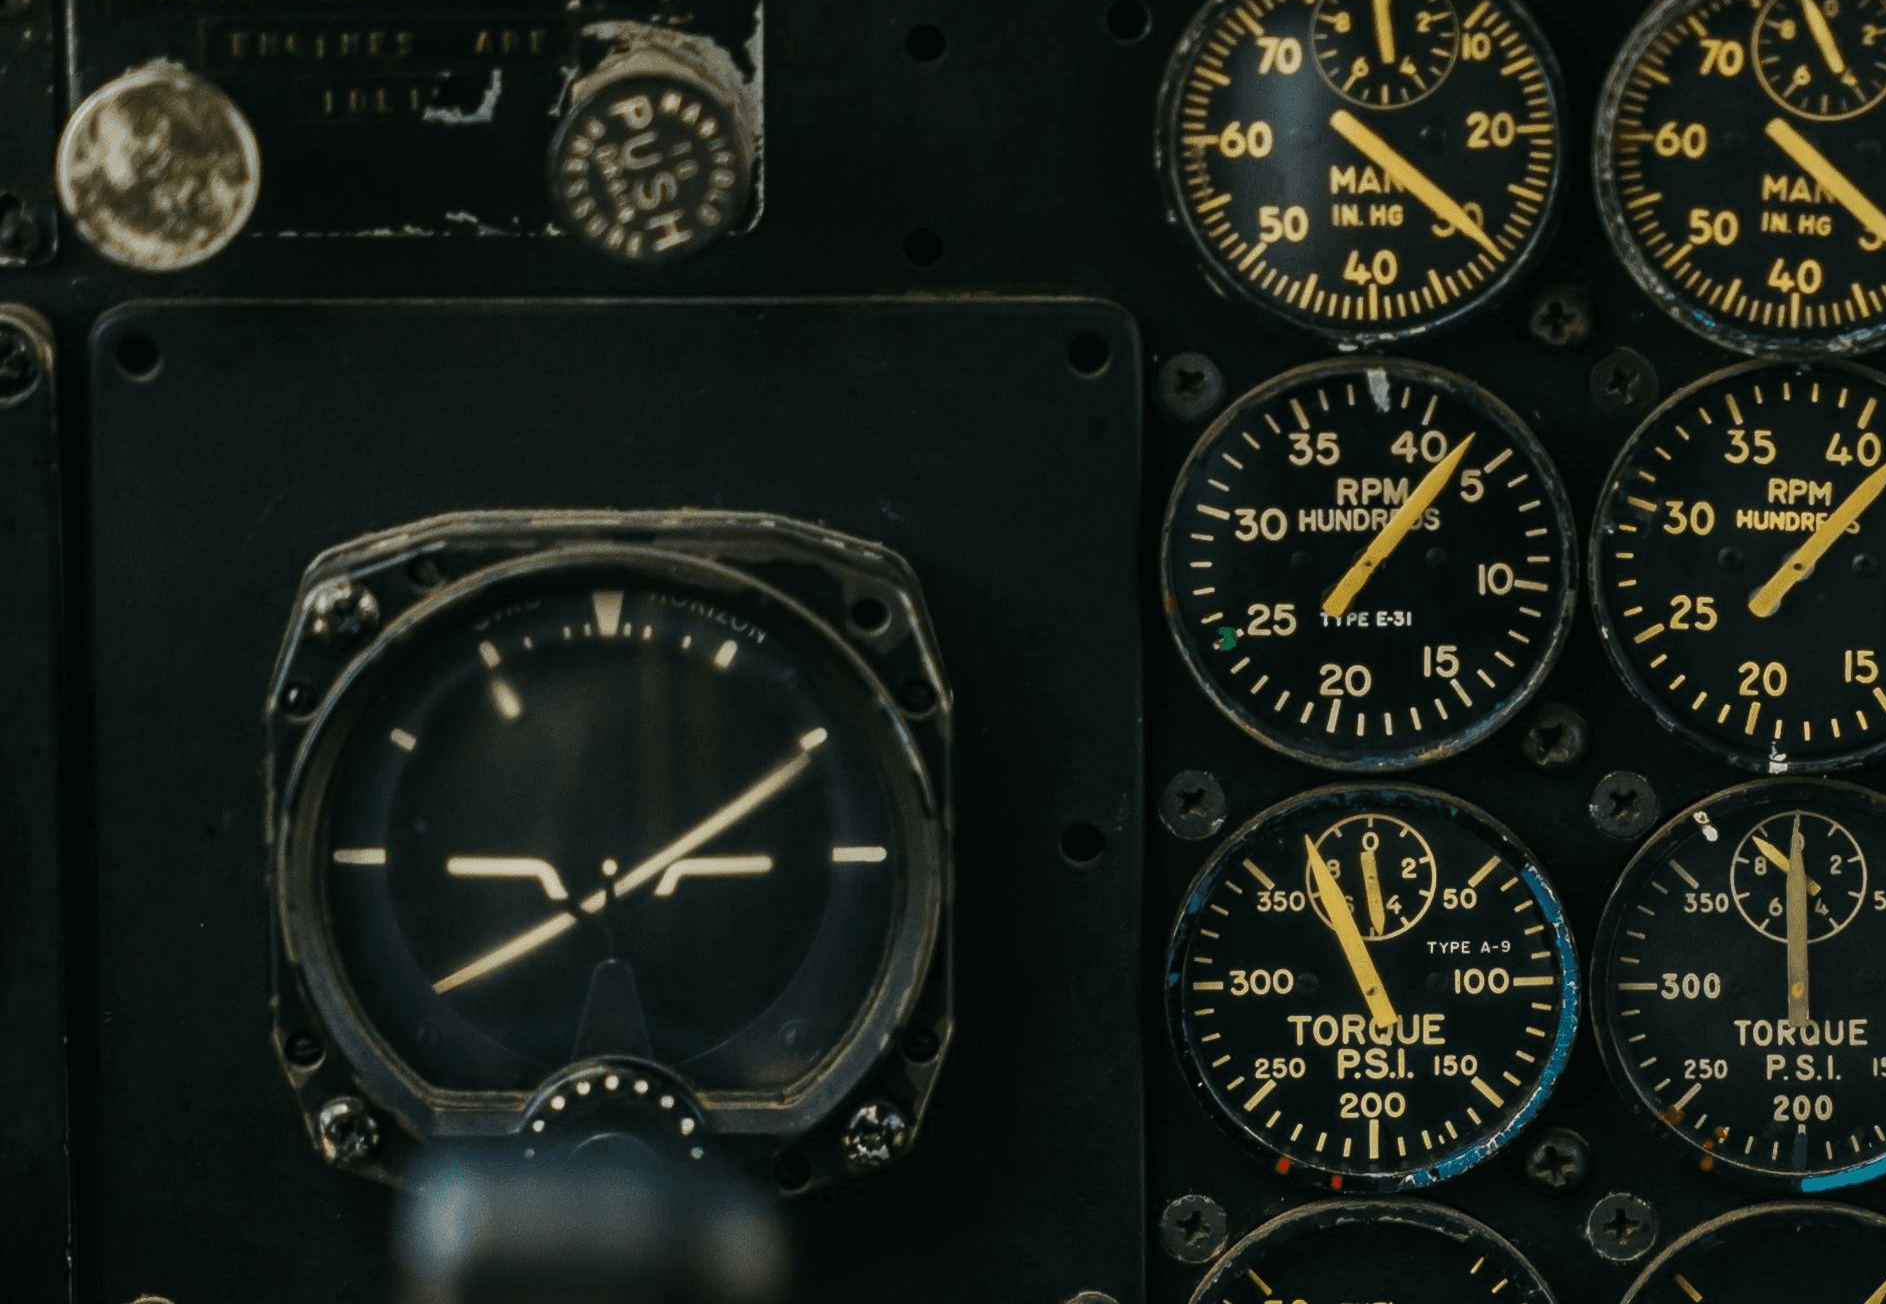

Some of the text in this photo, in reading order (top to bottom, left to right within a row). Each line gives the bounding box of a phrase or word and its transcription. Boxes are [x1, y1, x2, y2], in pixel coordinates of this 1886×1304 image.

[1256, 37, 1303, 75] 70
[1462, 32, 1492, 61] 10
[1699, 39, 1744, 77] 70
[1218, 120, 1273, 158] 60
[1466, 111, 1516, 149] 20
[1653, 121, 1707, 159] 60
[607, 94, 693, 253] PUSH
[1258, 206, 1309, 243] 50
[1370, 204, 1404, 227] HG
[1798, 214, 1832, 237] HG
[1343, 249, 1398, 286] 40
[1289, 432, 1341, 467] 35
[1391, 430, 1448, 463] 40
[1724, 429, 1776, 464] 35
[1336, 478, 1410, 506] RPM
[1767, 478, 1833, 506] RPM
[1234, 508, 1288, 542] 30
[1478, 563, 1514, 596] 10
[1247, 604, 1296, 637] 25
[1320, 611, 1413, 628] TYPE E-31
[1669, 595, 1718, 632] 25
[1423, 645, 1460, 678] 15
[1319, 664, 1372, 697] 20
[1738, 661, 1788, 697] 20
[1256, 891, 1306, 913] 350
[1442, 889, 1478, 910] 50
[1427, 941, 1512, 955] TYPE A-9
[1229, 968, 1294, 995] 300
[1454, 967, 1509, 995] 100
[1661, 973, 1721, 999] 300
[1287, 1014, 1445, 1047] TORQUE
[1734, 1018, 1869, 1047] TORQUE
[1337, 1048, 1414, 1080] P.S.I.
[1340, 1092, 1406, 1118] 200
[1773, 1095, 1834, 1122] 200
